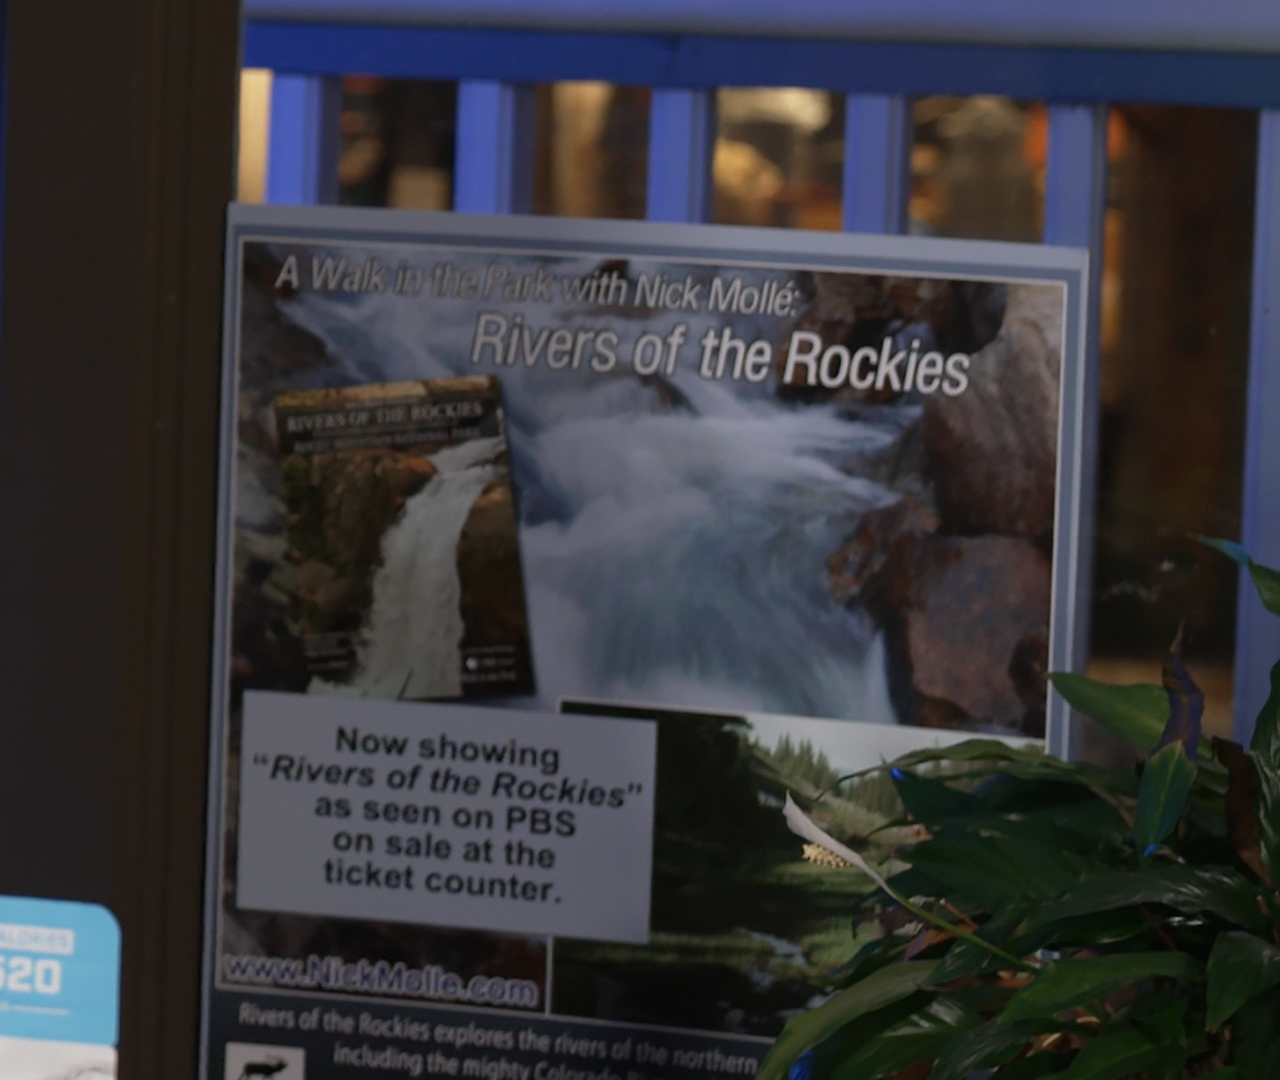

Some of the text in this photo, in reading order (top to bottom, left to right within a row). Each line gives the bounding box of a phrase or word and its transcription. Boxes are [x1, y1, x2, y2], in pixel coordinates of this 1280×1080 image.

[274, 258, 302, 291] A
[309, 258, 386, 295] Walk
[391, 263, 424, 295] in
[431, 265, 478, 298] the
[483, 265, 552, 303] Park
[560, 270, 628, 307] with
[632, 272, 701, 311] Nick
[470, 314, 973, 398] Rivers of the Rockies
[335, 725, 560, 774] Now showing
[386, 762, 423, 793] of
[430, 766, 480, 798] the
[313, 796, 577, 837] as seen on PBS
[333, 828, 556, 869] on sale at the
[324, 858, 563, 904] ticket counter.
[224, 953, 538, 1008] www.NickMolle.com
[239, 1001, 295, 1029] Rivers
[298, 1006, 322, 1031] of
[323, 1008, 355, 1034] the
[359, 1012, 430, 1042] Rockies
[434, 1021, 515, 1049] explores
[518, 1027, 550, 1052] the
[553, 1032, 606, 1058] rivers
[609, 1037, 630, 1060] of
[672, 1047, 759, 1075] northern
[334, 1042, 423, 1077] including
[427, 1050, 460, 1073] the
